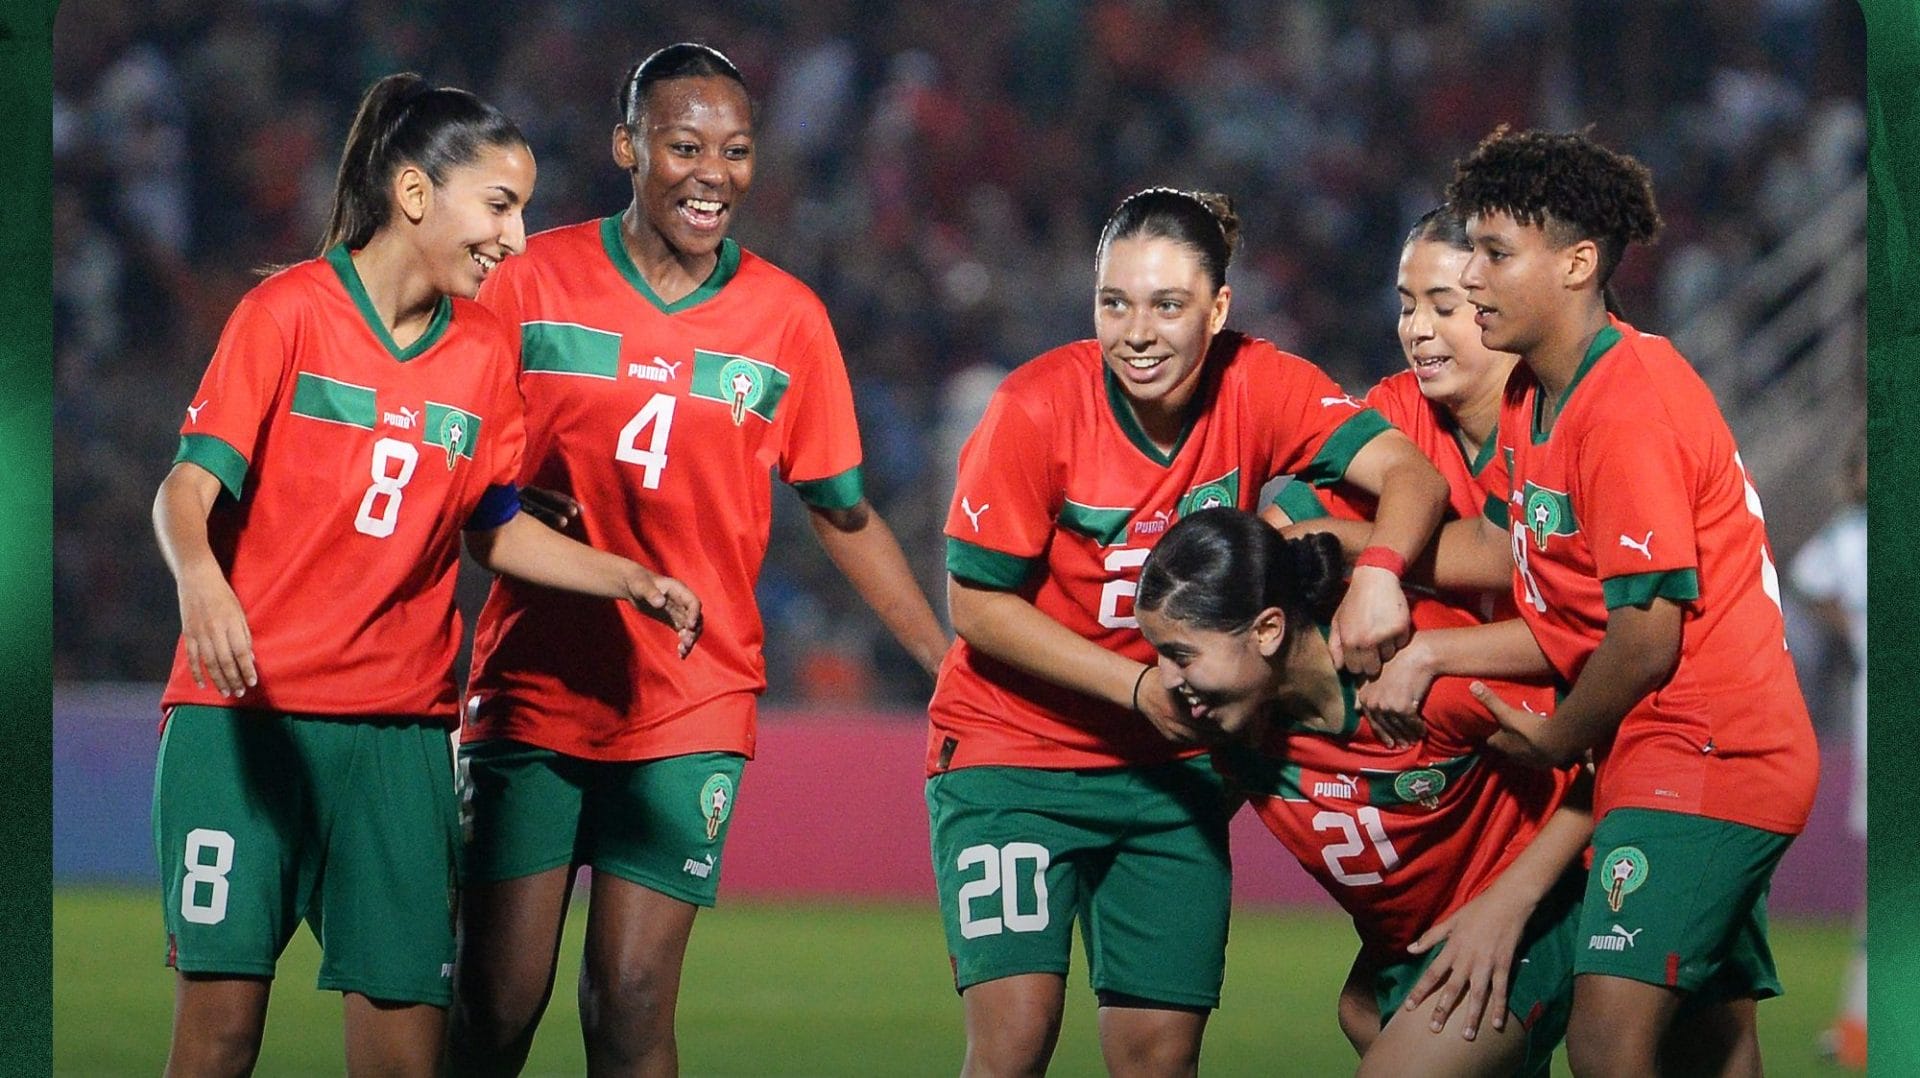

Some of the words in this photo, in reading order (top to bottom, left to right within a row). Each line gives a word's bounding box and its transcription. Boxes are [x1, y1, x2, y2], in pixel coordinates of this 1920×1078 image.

[628, 362, 668, 382] PUMA
[383, 411, 410, 430] PUMA
[615, 393, 677, 490] 4
[354, 437, 420, 539] 8
[1134, 520, 1165, 534] PUMA
[1313, 781, 1352, 799] PUMA
[1312, 806, 1399, 886] 21
[181, 828, 235, 925] 8
[682, 857, 714, 879] PUMA
[957, 842, 1050, 940] 20
[1588, 935, 1626, 952] PUMA
